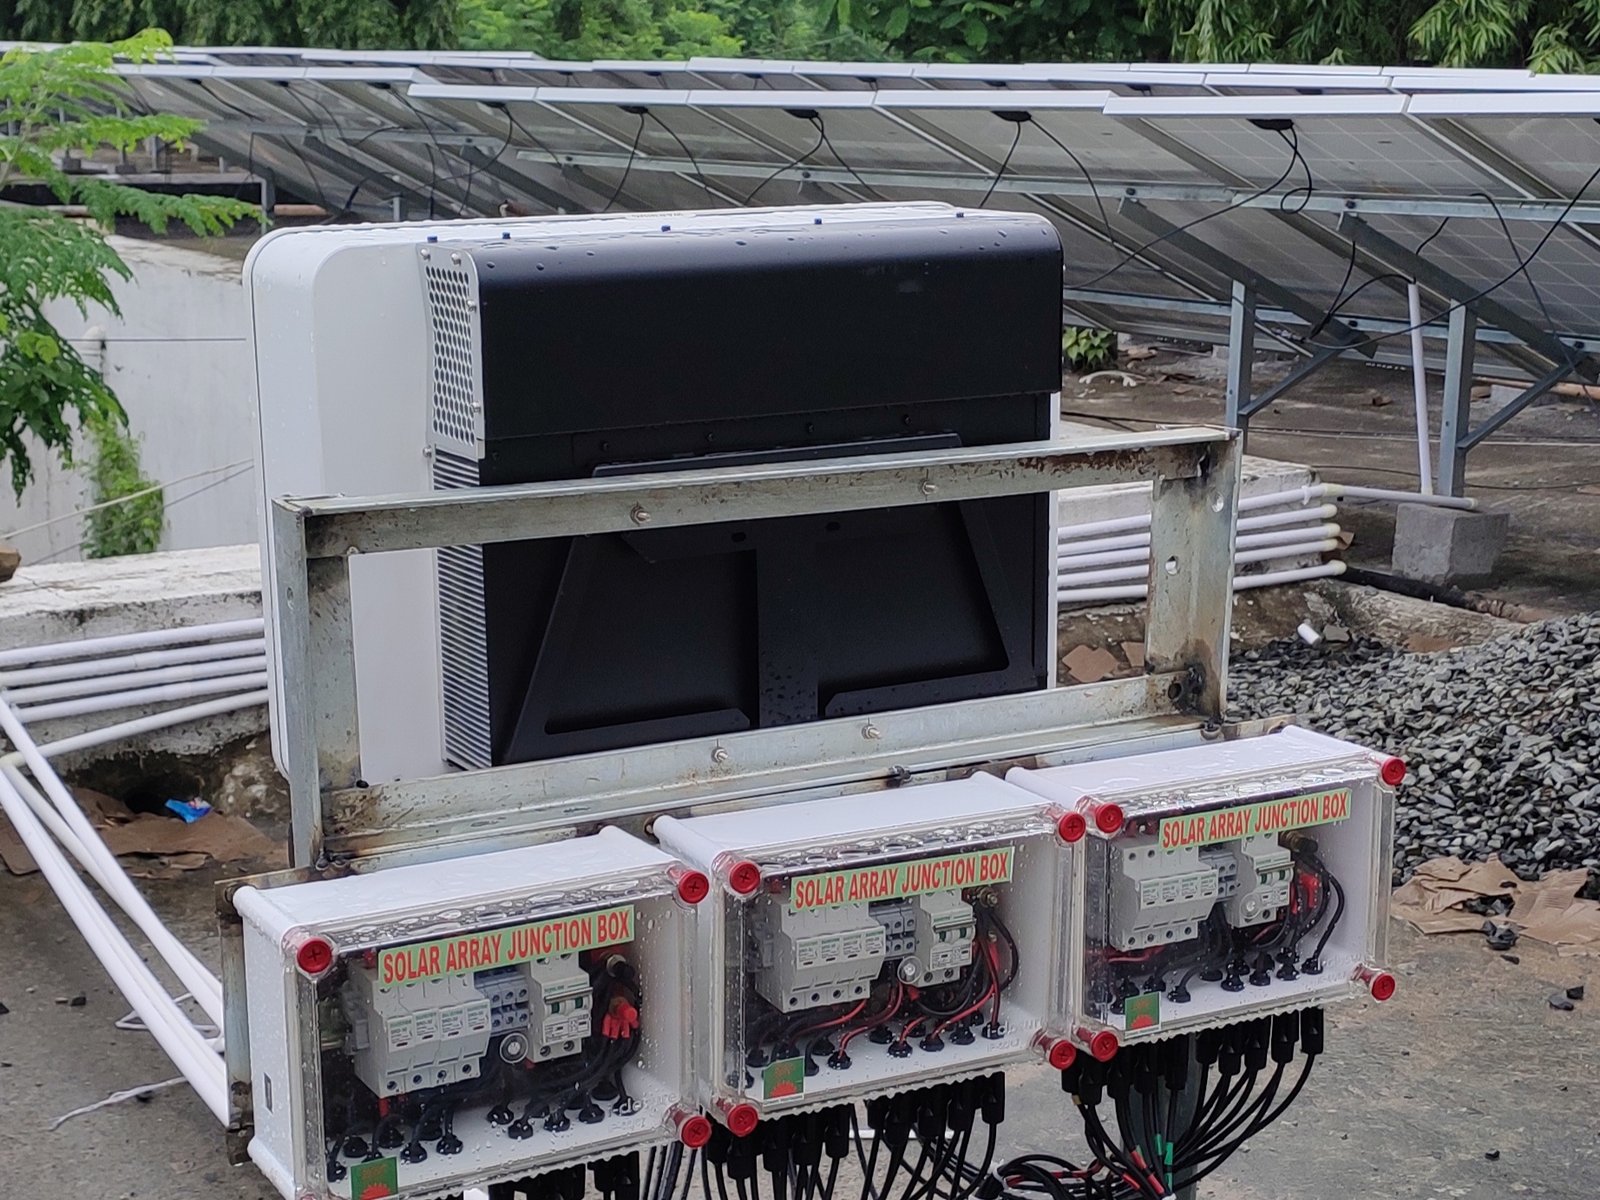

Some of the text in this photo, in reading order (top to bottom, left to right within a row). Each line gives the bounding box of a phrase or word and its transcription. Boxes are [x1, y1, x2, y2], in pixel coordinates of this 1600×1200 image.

[1162, 793, 1347, 849] SOLAR ARRAY JUNCTION BOX
[795, 851, 1008, 909] SOLAR ARRAY JUNCTION BOX
[383, 911, 629, 984] SOLAR ARRAY JUNCTION BOX
